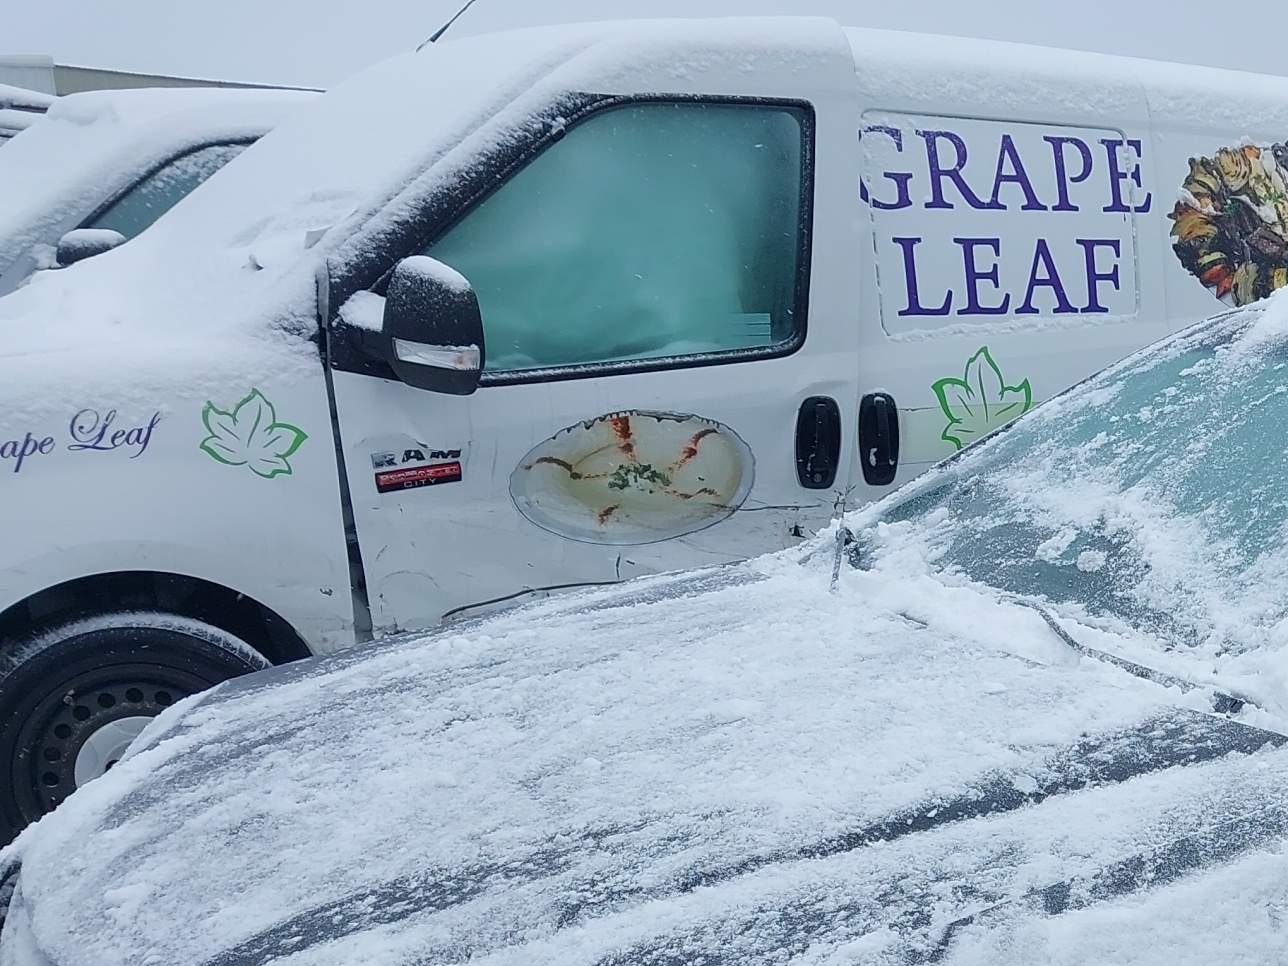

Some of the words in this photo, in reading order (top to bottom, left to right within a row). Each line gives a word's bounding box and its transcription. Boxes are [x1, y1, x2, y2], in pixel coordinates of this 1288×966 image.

[858, 125, 1152, 213] GRAPE
[892, 237, 1121, 316] LEAF
[68, 408, 160, 459] Leaf
[371, 449, 461, 469] RAM
[404, 478, 437, 488] CITY
